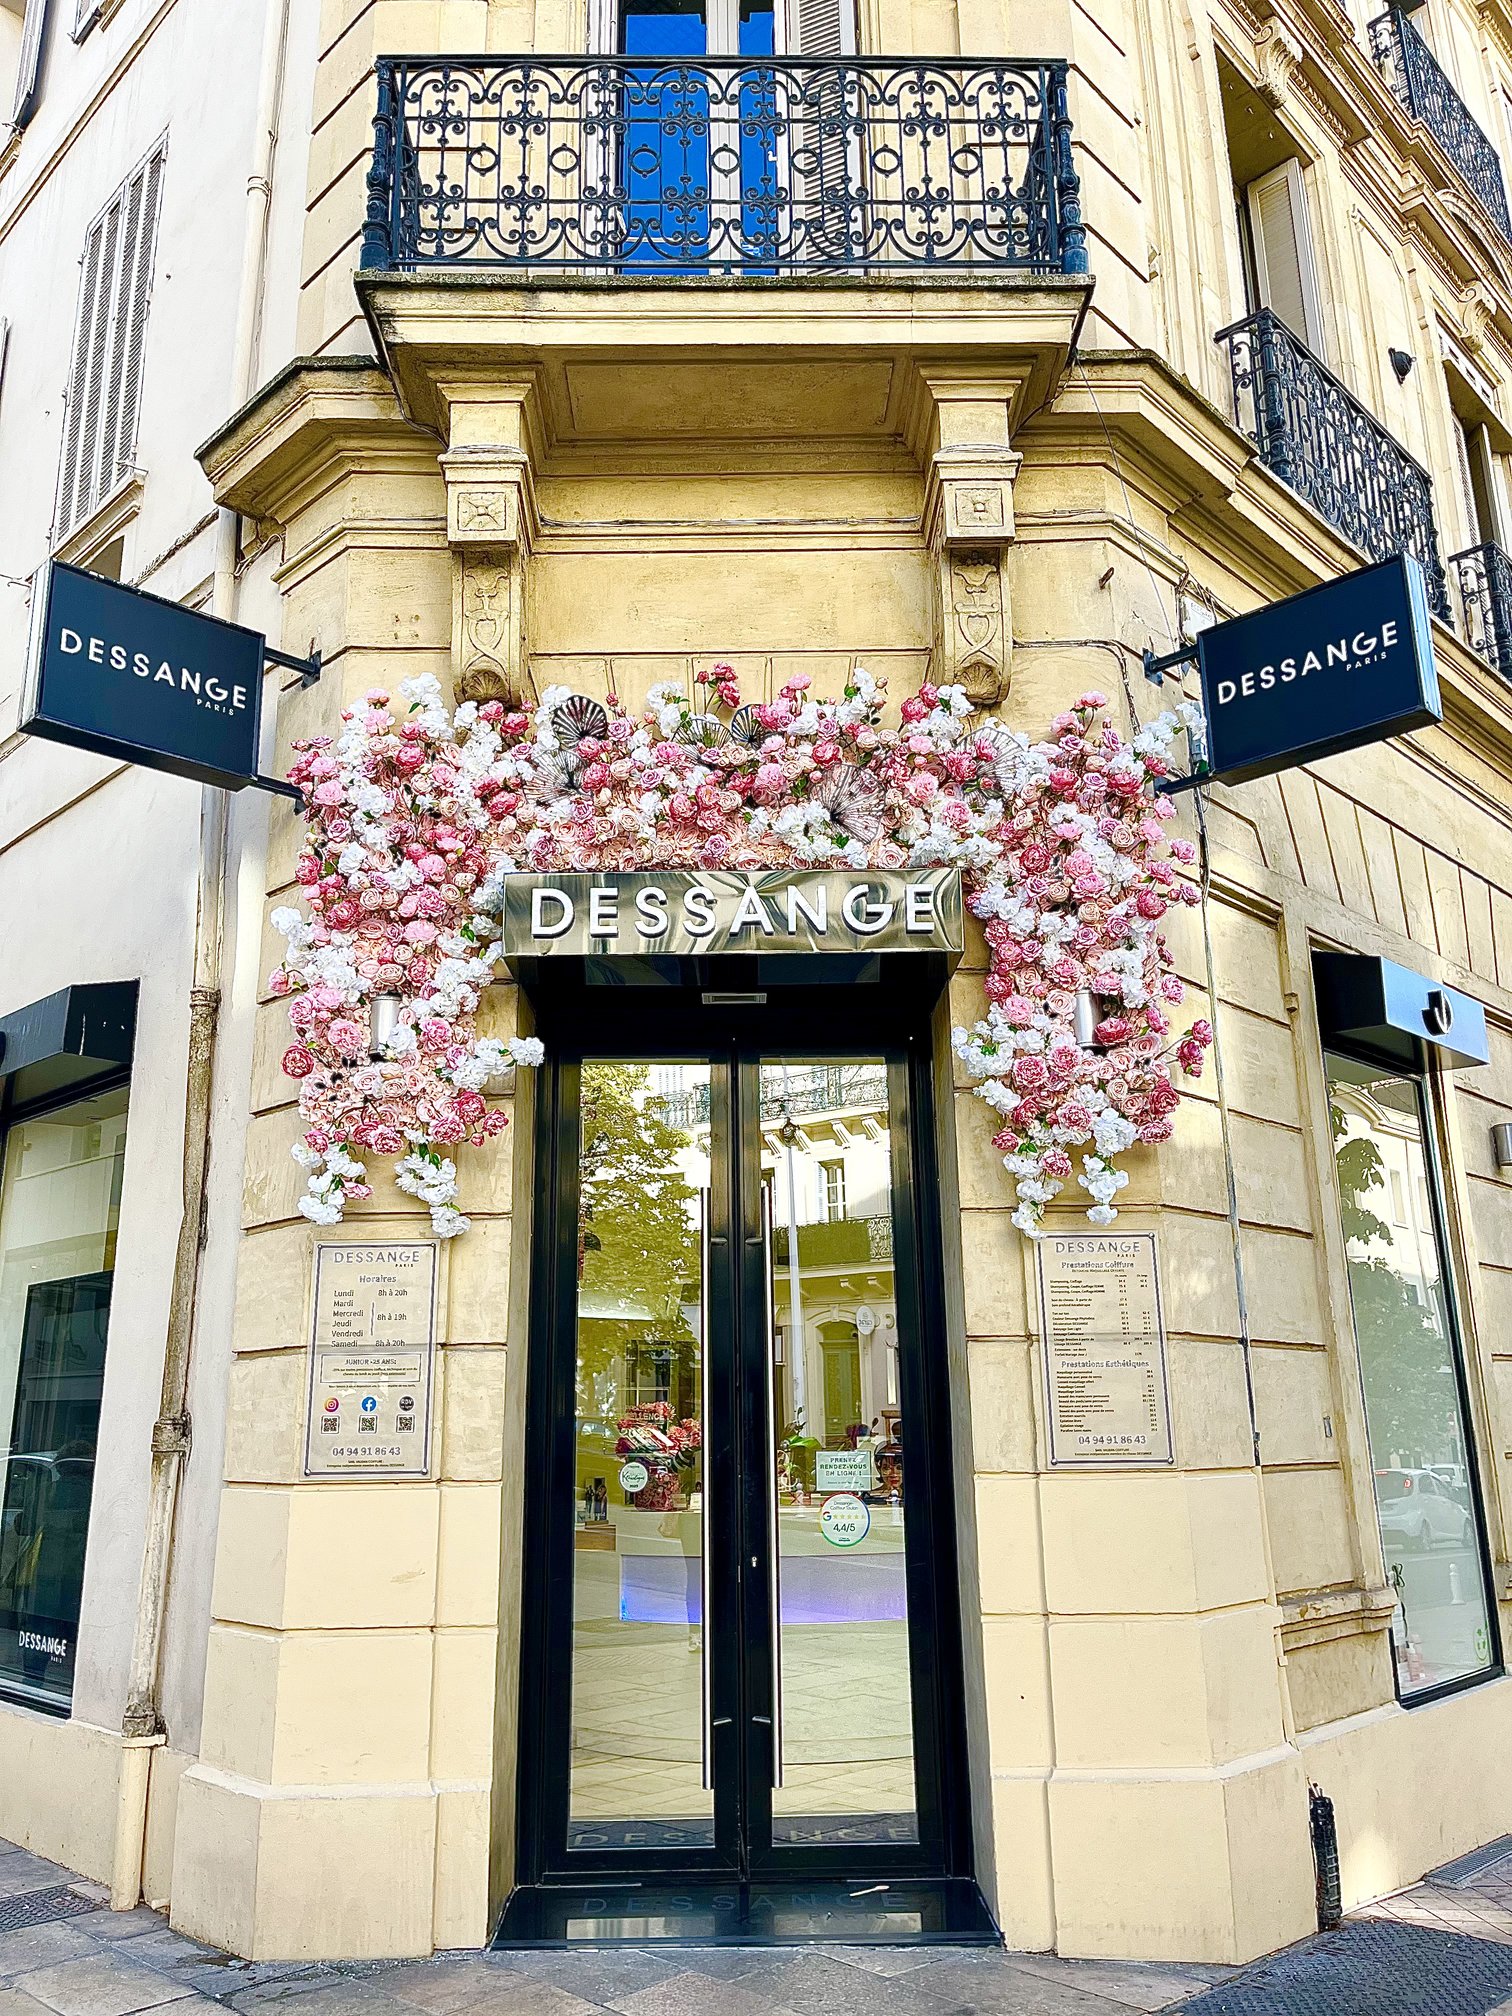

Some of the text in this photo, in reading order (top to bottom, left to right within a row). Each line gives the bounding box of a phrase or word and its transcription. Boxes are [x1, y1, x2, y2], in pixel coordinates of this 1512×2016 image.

[1217, 620, 1398, 705] DESSANGE
[1345, 651, 1387, 672] PARIS
[59, 627, 248, 710] DESSANGE
[196, 698, 235, 716] PARIS
[530, 883, 937, 939] DESSANGE
[1055, 1241, 1140, 1253] DESSANGE
[334, 1250, 420, 1263] DESSANGE
[1061, 1260, 1134, 1269] Prestations Coiffure
[359, 1274, 397, 1283] Horaires
[333, 1299, 354, 1307] Mardi
[1105, 1360, 1149, 1369] Esthétiques
[1078, 1435, 1146, 1444] 04 94 91 86 43
[332, 1446, 401, 1456] 04 94 91 86 43
[833, 1523, 856, 1532] 4,4/5
[18, 1630, 68, 1657] DESSANGE
[582, 1892, 909, 1914] DESSANGE
